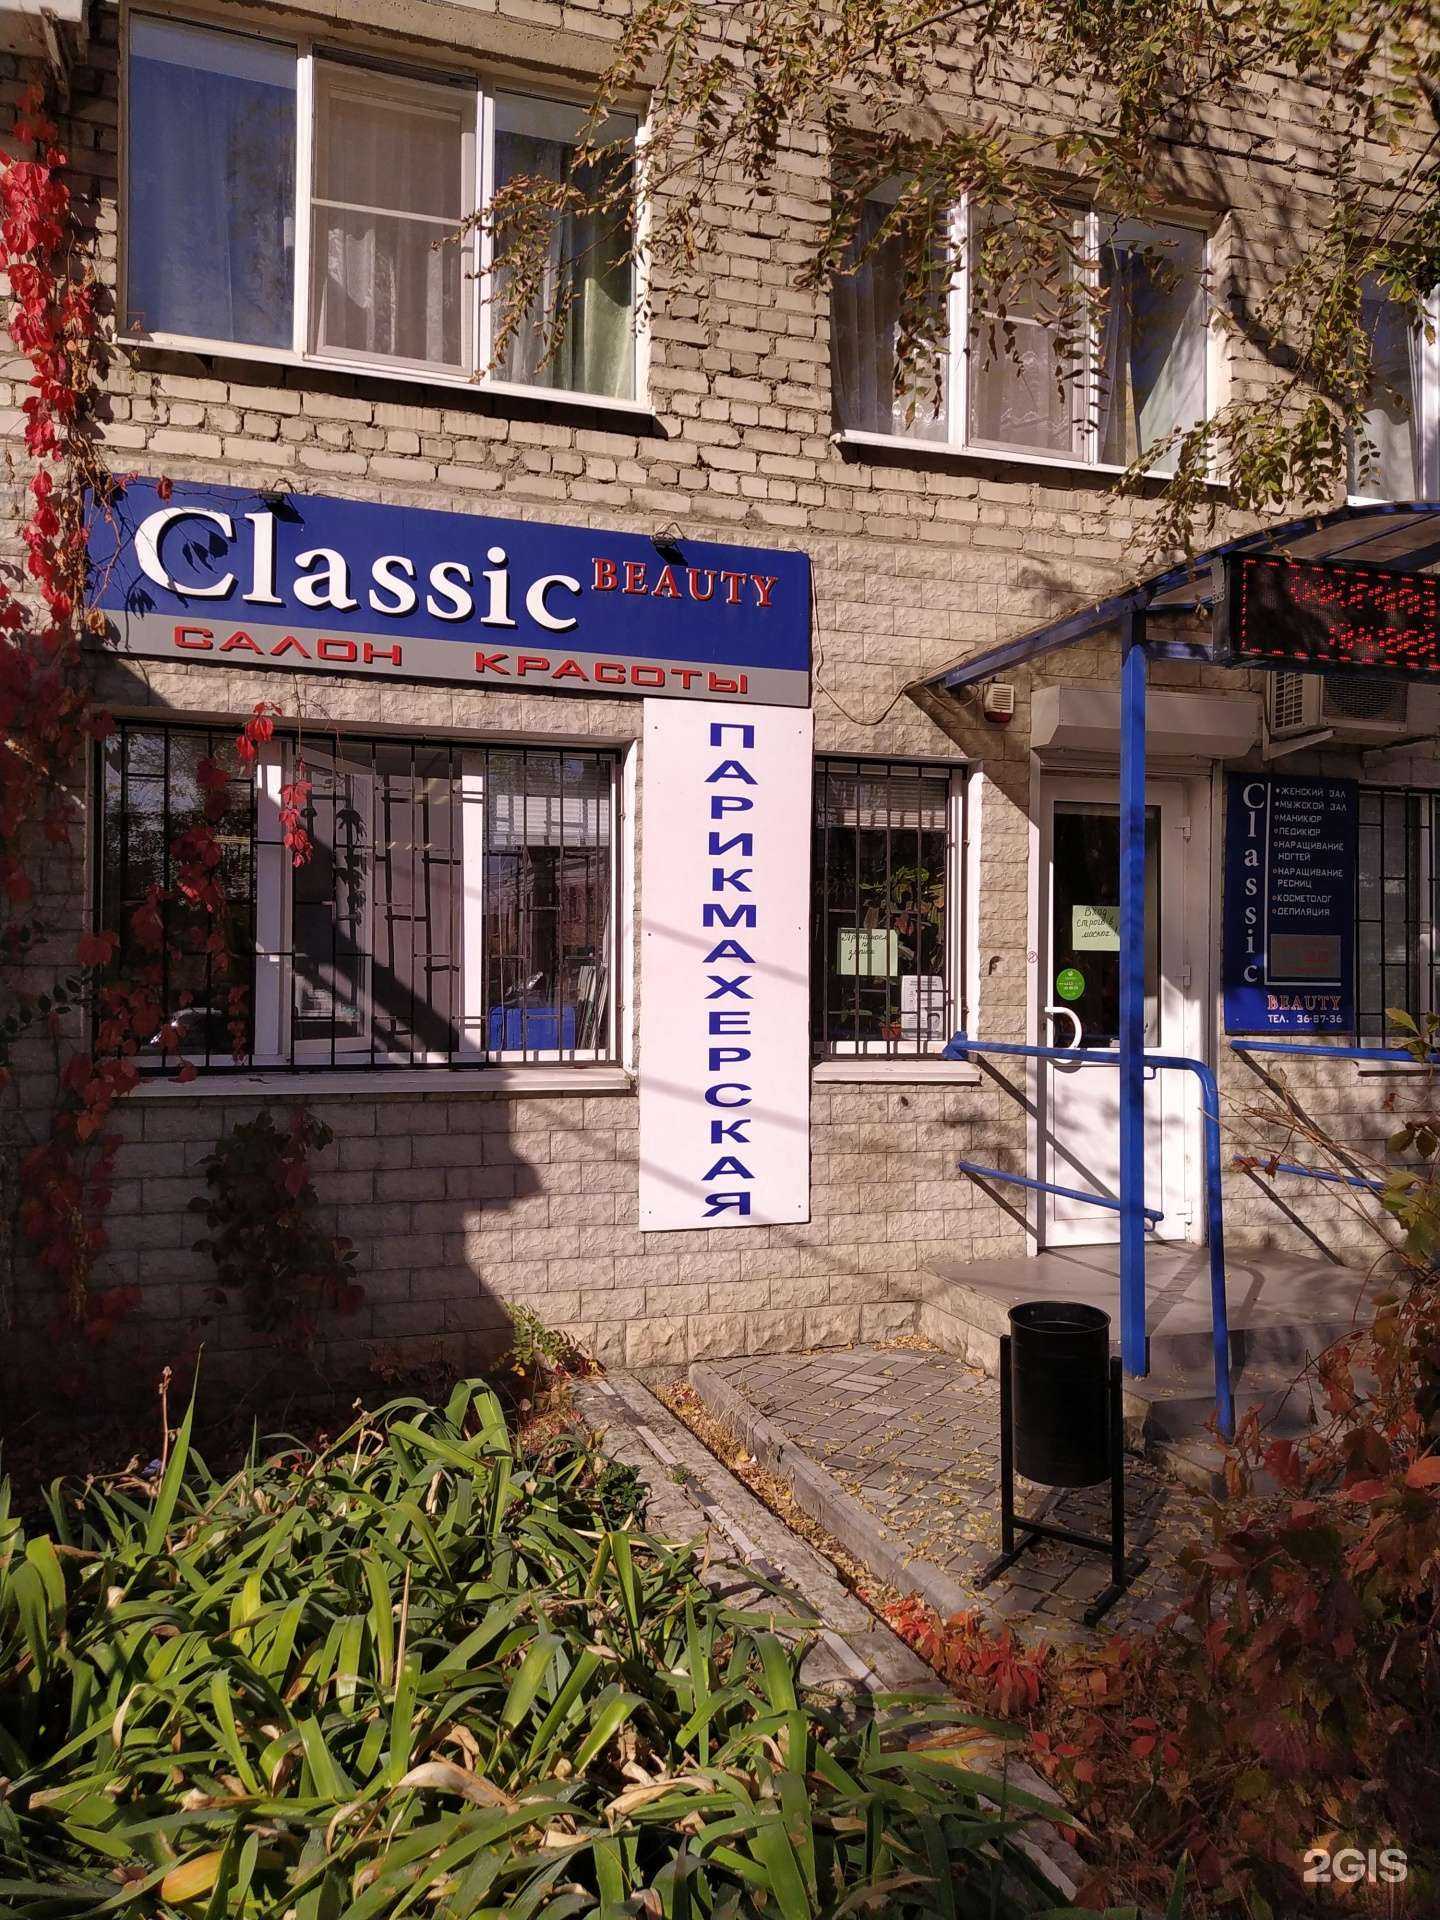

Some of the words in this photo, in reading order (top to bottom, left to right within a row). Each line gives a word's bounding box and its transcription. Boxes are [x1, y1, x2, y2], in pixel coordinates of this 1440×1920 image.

[133, 505, 581, 631] Classic
[591, 556, 780, 607] BEAUTY
[174, 625, 402, 667] САЛОН
[475, 651, 749, 694] КРАСОТЫ
[1281, 786, 1324, 797] ЖЕНСКИЙ
[1329, 789, 1346, 798] ЗАЛ
[1279, 800, 1324, 810] МУЖСКОЙ
[1330, 802, 1347, 811] ЗАЛ
[1279, 814, 1322, 823] МАНИКЮР
[1278, 827, 1321, 836] ПЕДИКЮР
[1278, 841, 1344, 851] НАРАЩИВАНИЕ
[1278, 852, 1311, 861] НОГТЕЙ
[1278, 867, 1343, 878] НАРАЩИВАНИЕ
[1242, 783, 1265, 983] Classic
[1278, 879, 1312, 889] РЕСНИЦ
[1277, 894, 1333, 904] КОСМЕТОЛОГ
[1277, 908, 1330, 917] ДЕПИЛЯЦИЯ
[701, 722, 759, 1217] ПАРИКМАХЕРСКАЯ
[1267, 994, 1342, 1011] BEAUTY
[1267, 1014, 1289, 1024] ТЕЛ.
